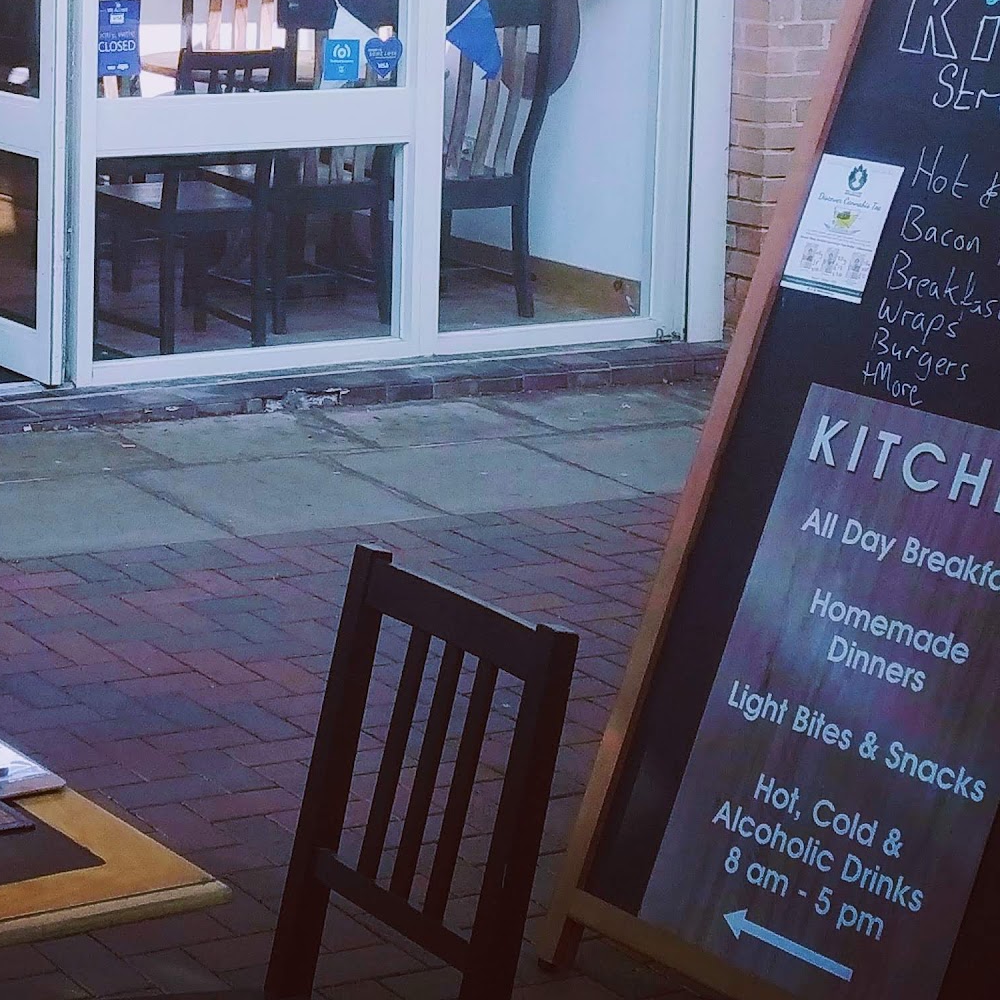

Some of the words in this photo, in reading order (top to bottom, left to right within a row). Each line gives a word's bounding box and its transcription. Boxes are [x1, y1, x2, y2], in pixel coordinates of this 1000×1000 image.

[98, 40, 136, 53] CLOSED
[911, 145, 969, 199] Hot
[900, 204, 981, 254] Bacon
[887, 249, 1000, 321] Breakfas
[871, 326, 969, 382] Burgers
[877, 296, 957, 346] Wraps
[808, 414, 1000, 515] KITCH
[800, 507, 838, 540] All
[841, 518, 897, 562] Day
[809, 587, 970, 665] Homemade
[826, 633, 928, 693] Dinners
[727, 679, 789, 726] Light
[792, 704, 853, 751] Bites
[858, 730, 880, 761] &
[884, 740, 987, 803] Snacks
[753, 772, 801, 822] Hot,
[812, 798, 879, 848] Cold
[882, 827, 905, 859] &
[711, 800, 835, 873] Alcoholic
[840, 852, 925, 913] Drinks
[724, 845, 742, 874] 8
[746, 861, 790, 898] am
[814, 885, 834, 916] 5
[835, 902, 885, 942] pm
